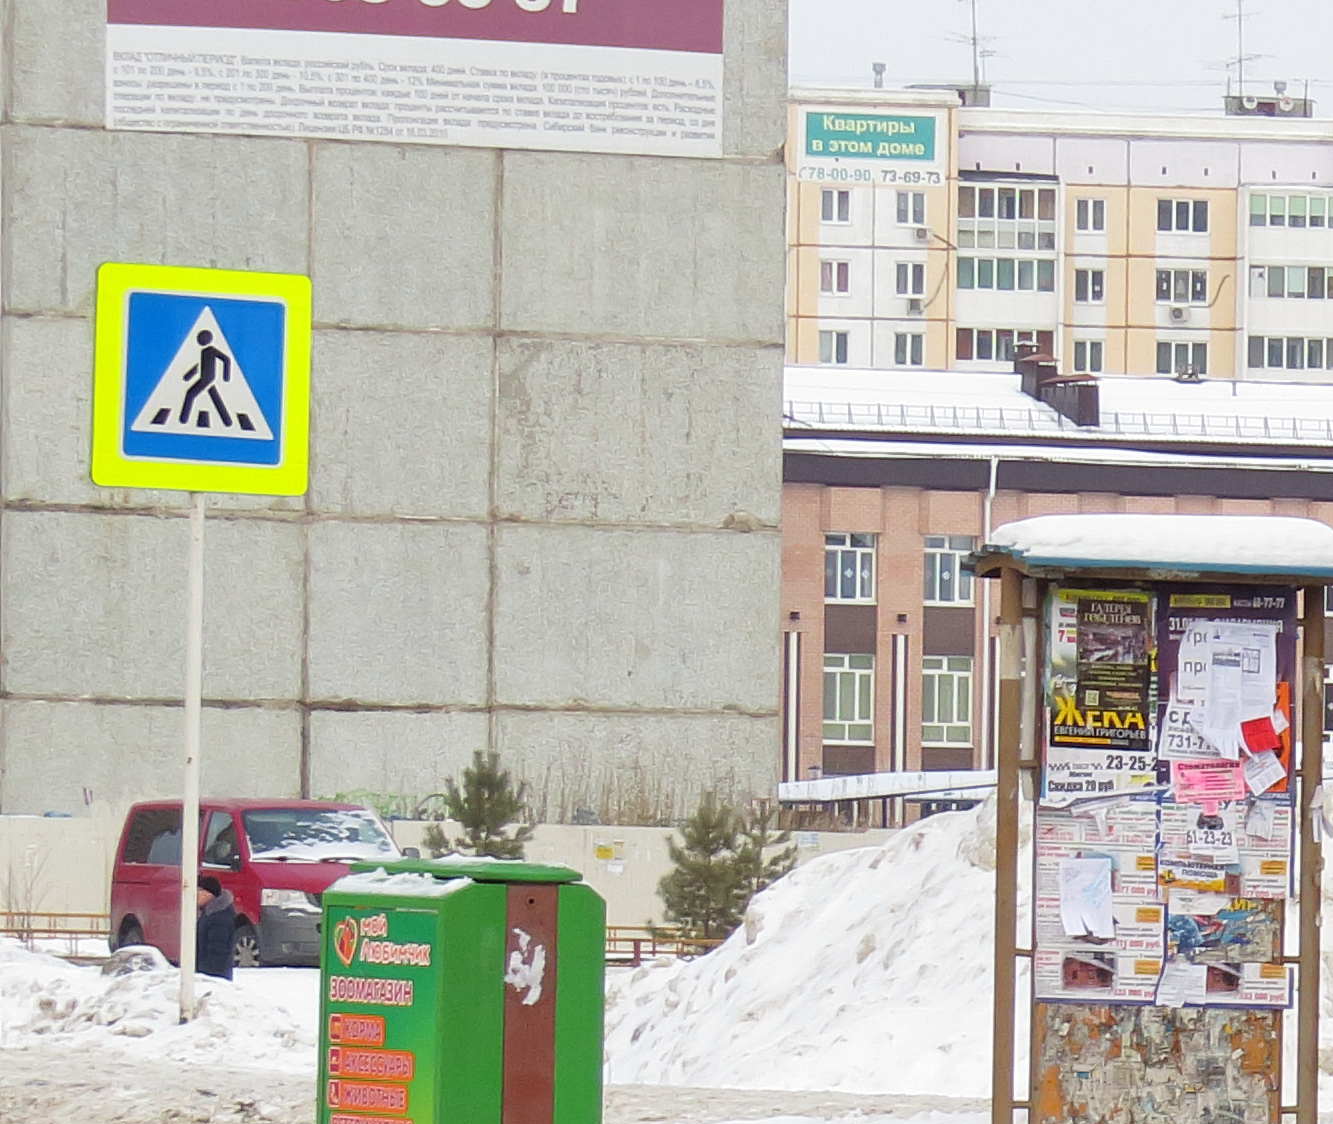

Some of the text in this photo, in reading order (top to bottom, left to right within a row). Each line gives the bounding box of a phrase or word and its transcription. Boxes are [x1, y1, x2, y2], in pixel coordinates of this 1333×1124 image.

[823, 115, 915, 136] Квартиры
[812, 140, 925, 156] в этом доме
[881, 169, 940, 184] 73-69-73
[1054, 726, 1146, 740] ЕВГЕНИЙ ГРИГОРЬЕВ
[1048, 780, 1083, 792] Скидка
[330, 975, 414, 1006] ЗООМАГАЗИН
[344, 1018, 382, 1041] КОРМА
[344, 1051, 412, 1077] АКСЕССУАРЫ
[343, 1083, 405, 1109] ЖИВОТНЫЕ
